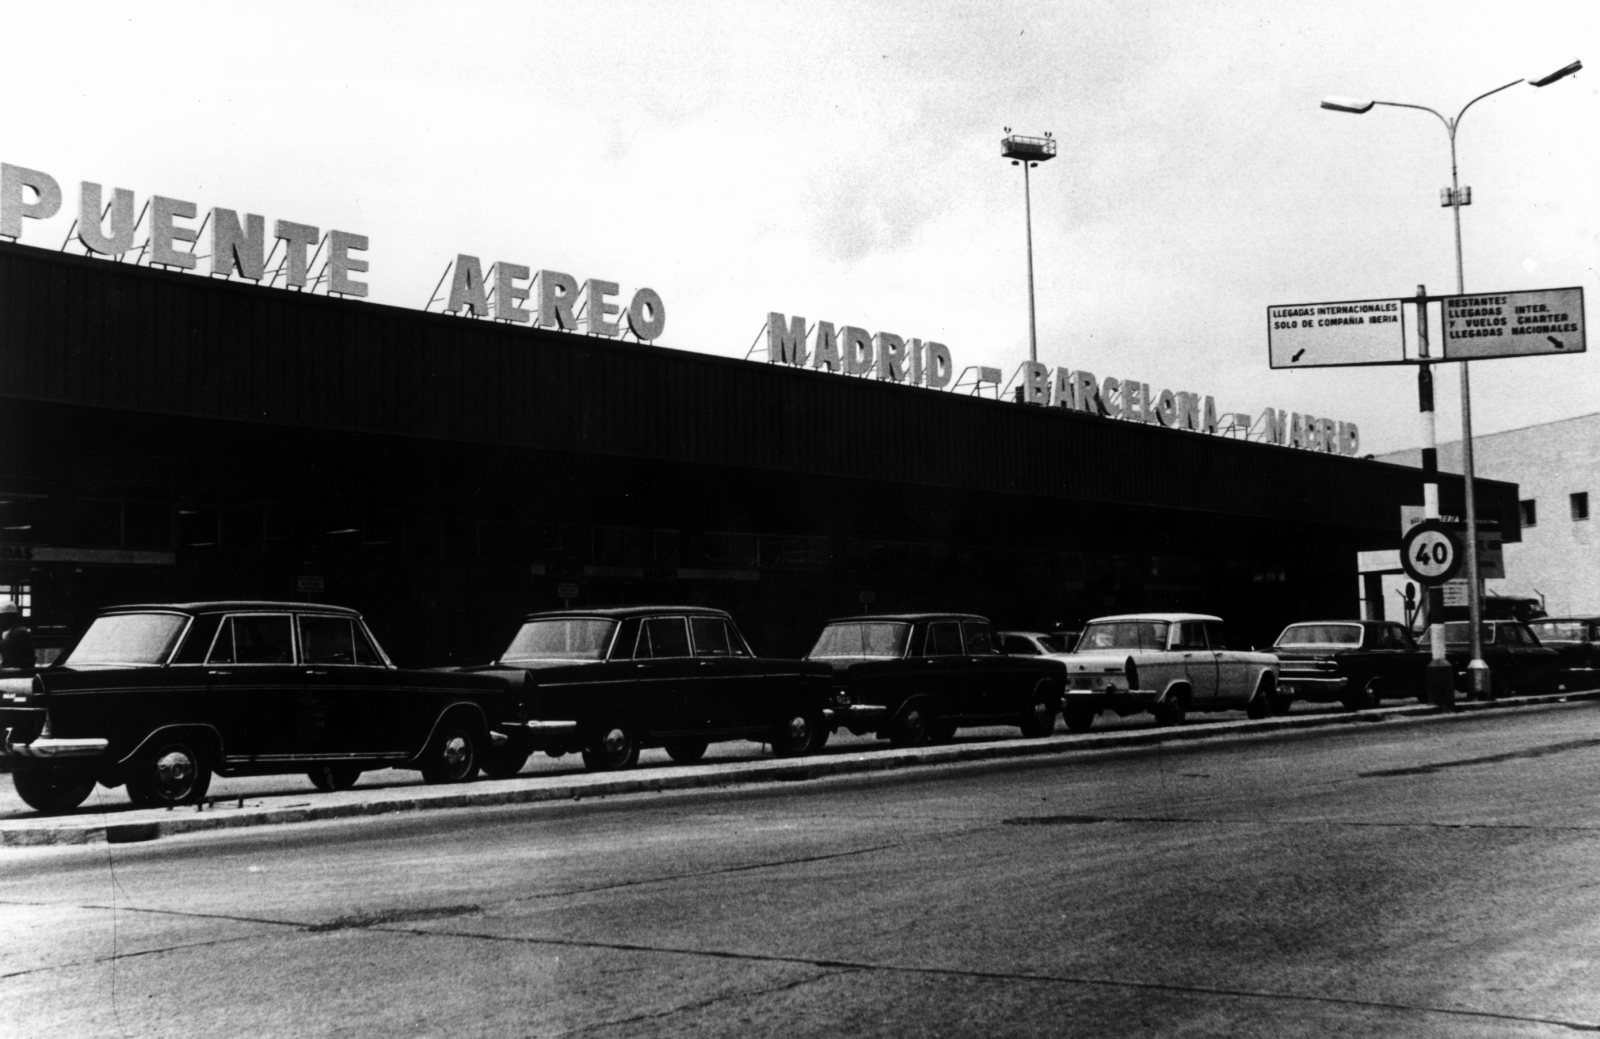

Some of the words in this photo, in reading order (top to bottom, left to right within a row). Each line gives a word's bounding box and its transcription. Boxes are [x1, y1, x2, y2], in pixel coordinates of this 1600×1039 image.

[0, 162, 369, 298] PUENTE
[447, 253, 665, 341] AEREO
[767, 311, 952, 389] MADRID
[1024, 360, 1218, 433] BARCELONA
[1265, 407, 1360, 455] MADRID
[1448, 297, 1507, 308] RESTANTES
[1273, 308, 1315, 318] LLEGADAS
[1317, 304, 1397, 315] INTERNACIONALES
[1448, 307, 1502, 318] LLEGADAS
[1274, 320, 1298, 329] SOLO
[1302, 319, 1314, 328] DE
[1318, 316, 1364, 327] COMPAÑIA
[1369, 315, 1398, 324] IBERIA
[1465, 317, 1507, 328] VUELOS
[1517, 313, 1568, 325] CHARTER
[1449, 328, 1503, 339] LLEGADAS
[1511, 323, 1578, 335] NACIONALES
[1416, 542, 1447, 565] 40
